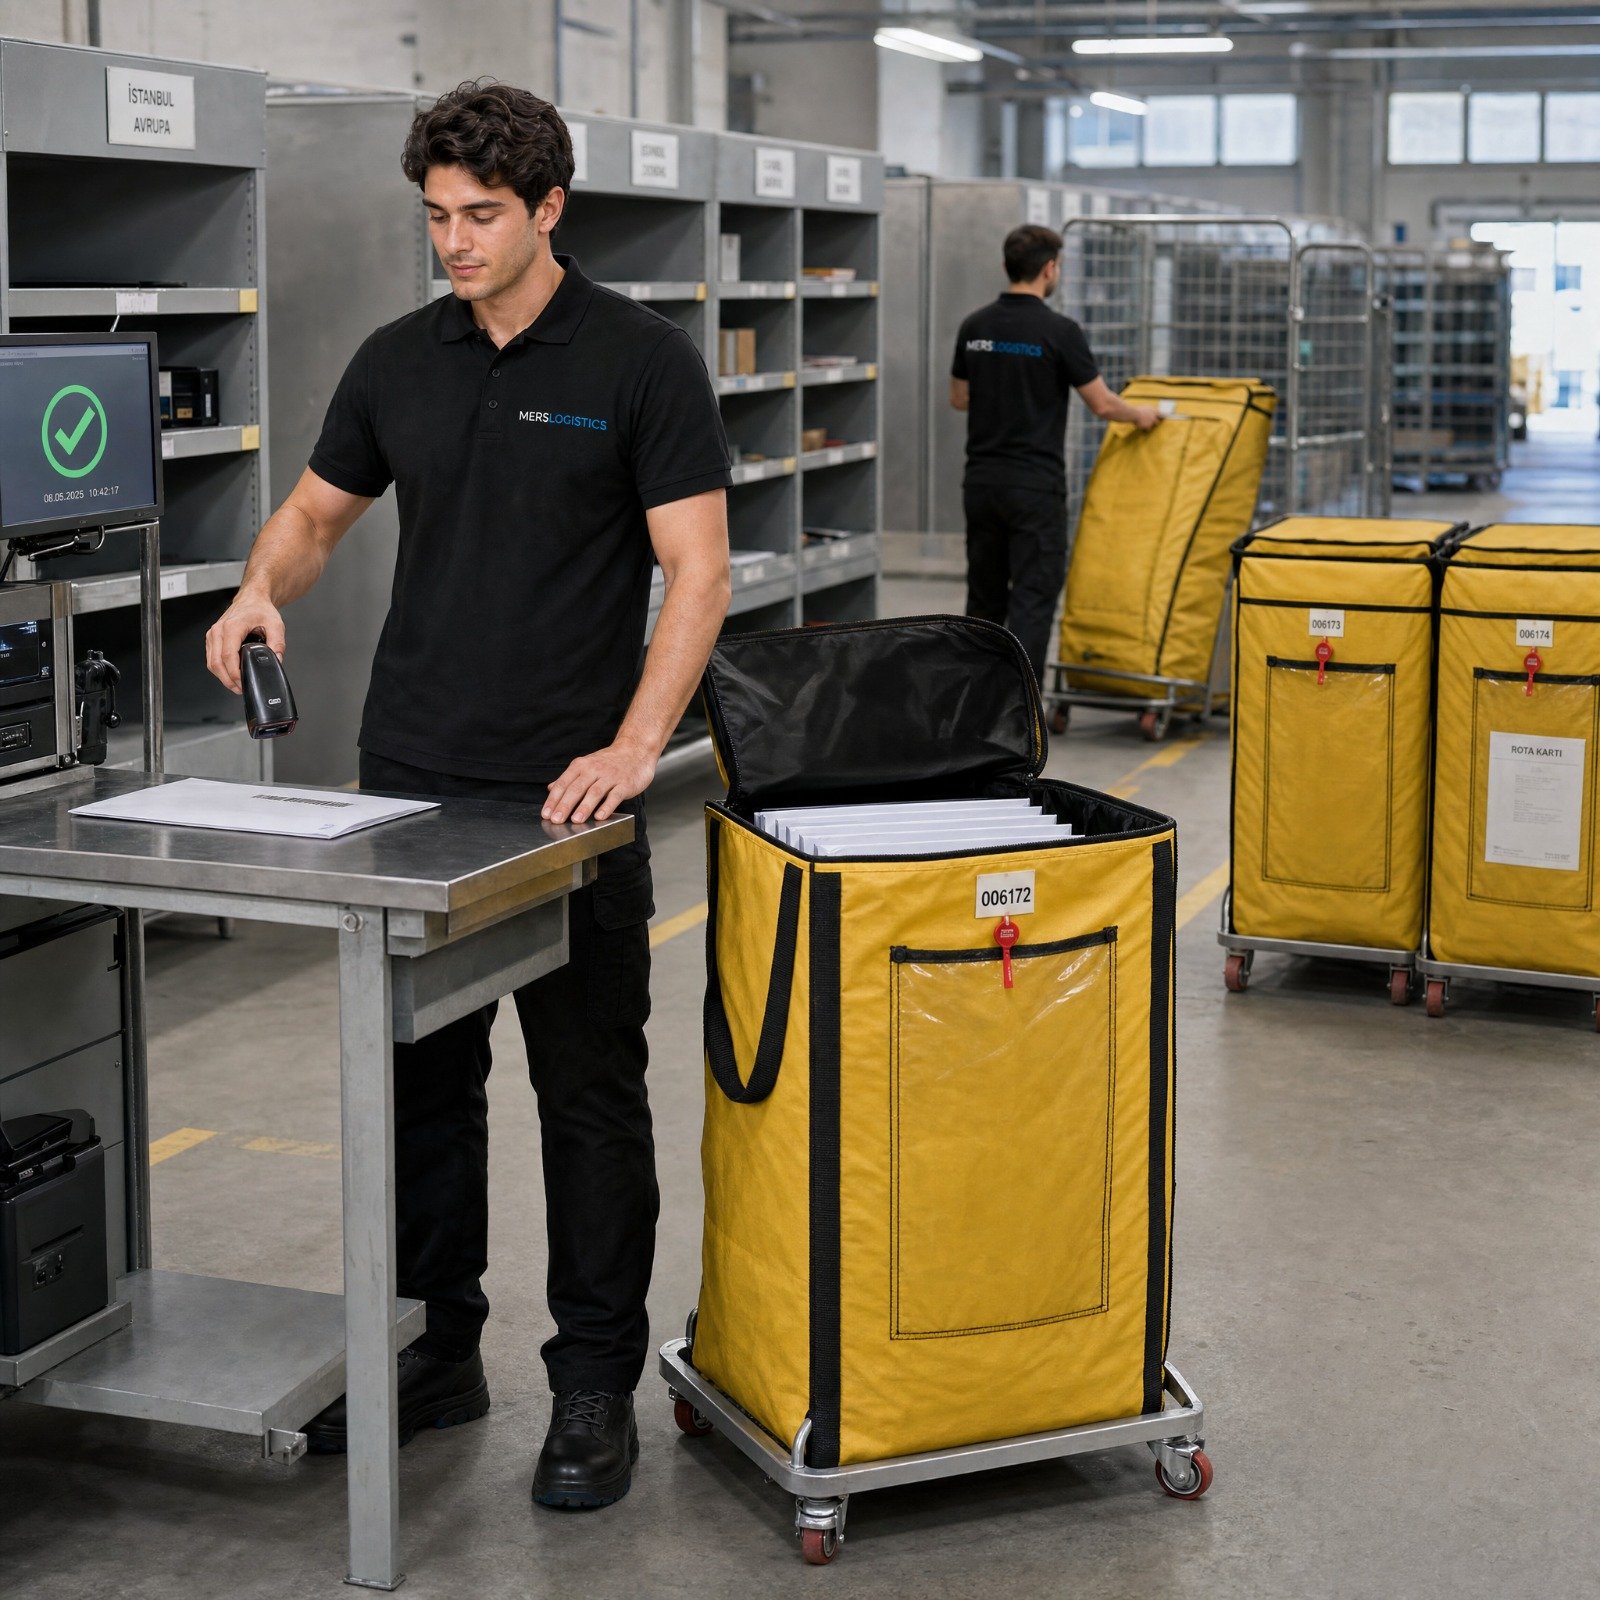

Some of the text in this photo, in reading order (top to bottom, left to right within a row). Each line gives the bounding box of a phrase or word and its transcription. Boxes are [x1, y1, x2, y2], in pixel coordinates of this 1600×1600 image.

[128, 82, 175, 107] İSTANBUL
[133, 117, 171, 135] AVRUPA
[519, 410, 608, 431] MERSLOGISTICS
[43, 485, 119, 503] 08.05.2025 10:42:17
[1312, 619, 1341, 630] 006173
[1519, 629, 1550, 640] 006174
[1511, 745, 1562, 758] ROTA KARTI
[981, 886, 1032, 907] 006172
